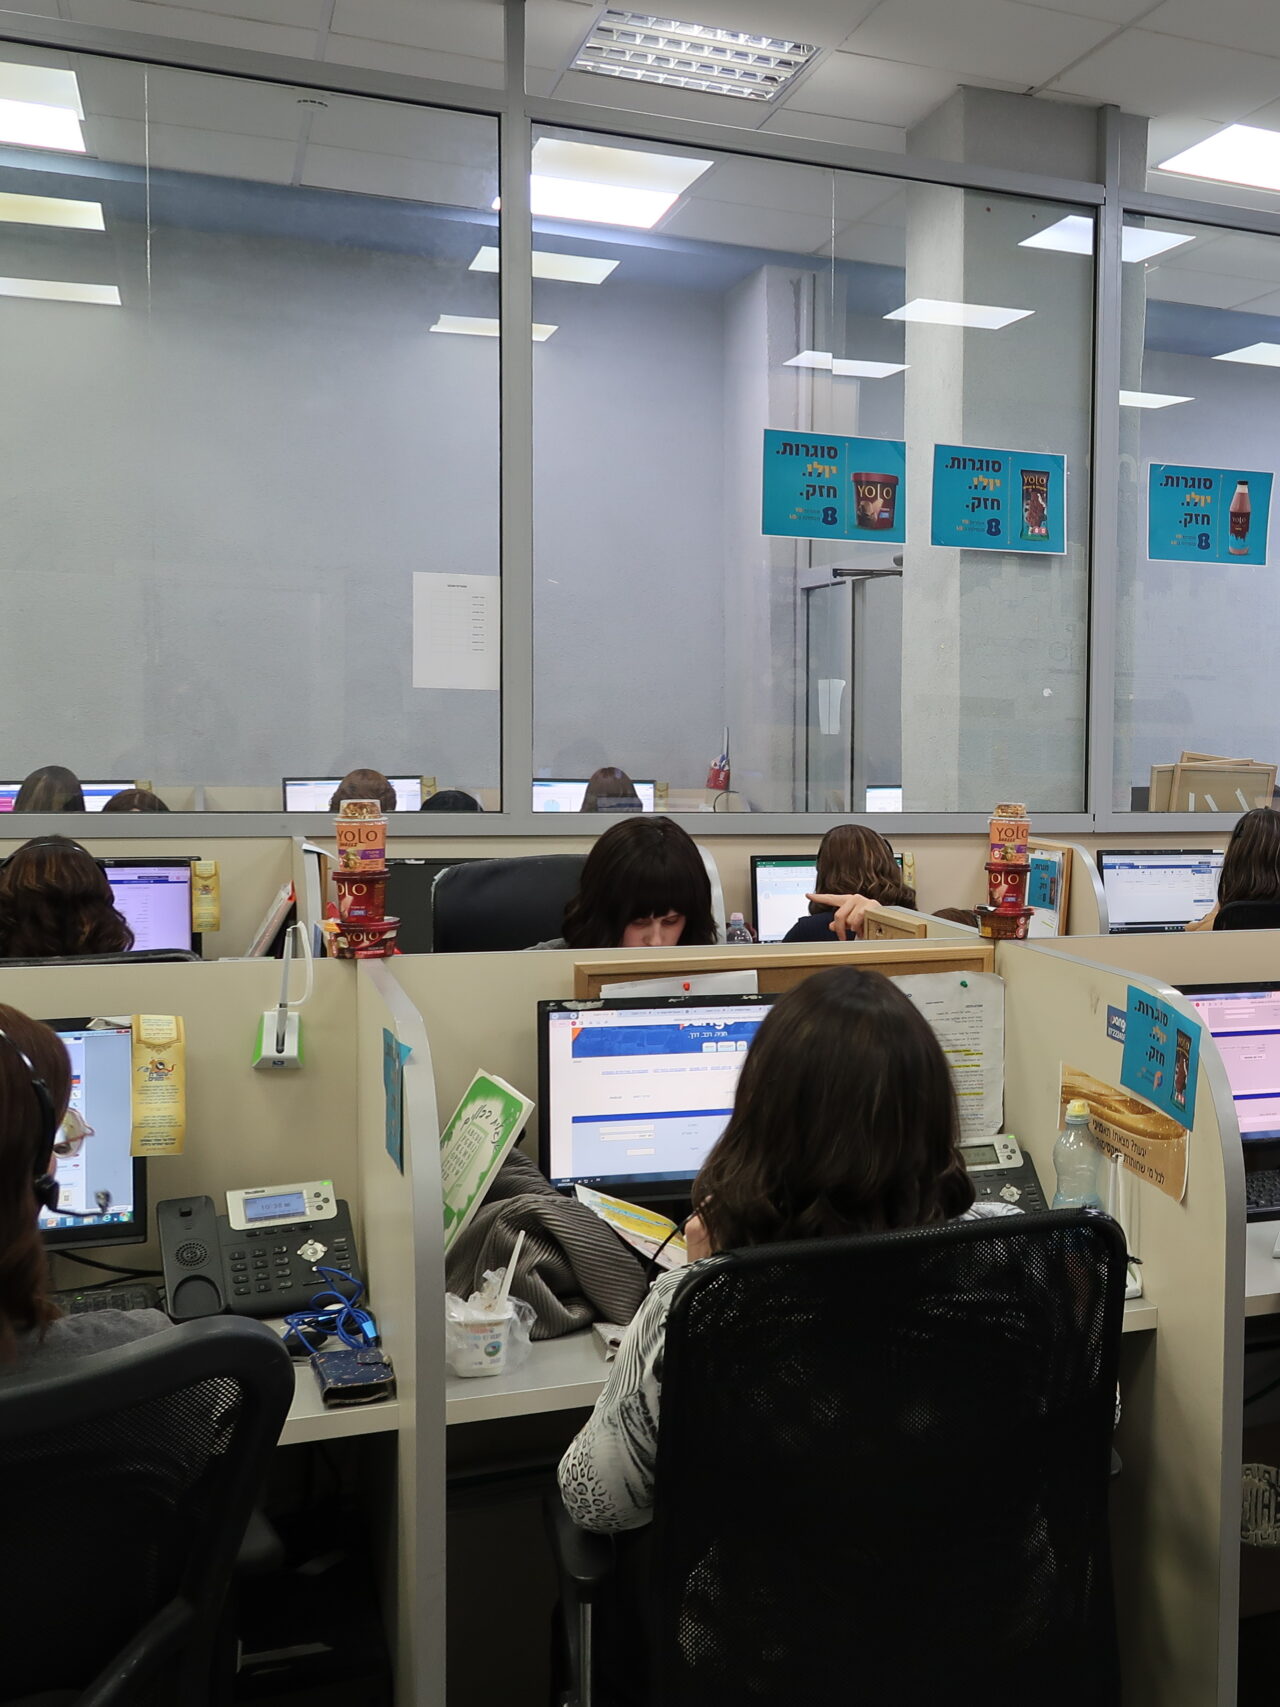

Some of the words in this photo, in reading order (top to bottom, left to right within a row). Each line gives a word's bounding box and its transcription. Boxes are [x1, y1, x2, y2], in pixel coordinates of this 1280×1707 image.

[776, 442, 838, 459] סוגרות.
[945, 456, 1002, 472] סוגרות.
[1024, 475, 1046, 485] YOLO
[1160, 475, 1212, 489] סוגרות.
[800, 484, 837, 500] חזק.
[858, 484, 892, 500] YOLO
[965, 496, 1001, 512] חזק.
[1179, 513, 1210, 527] חזק.
[338, 828, 378, 844] YOLO
[991, 872, 1019, 886] OLO
[338, 881, 367, 897] OLO
[345, 932, 379, 944] YOLO
[1134, 1000, 1168, 1027] סוגרות.
[1146, 1045, 1165, 1067] חזק.
